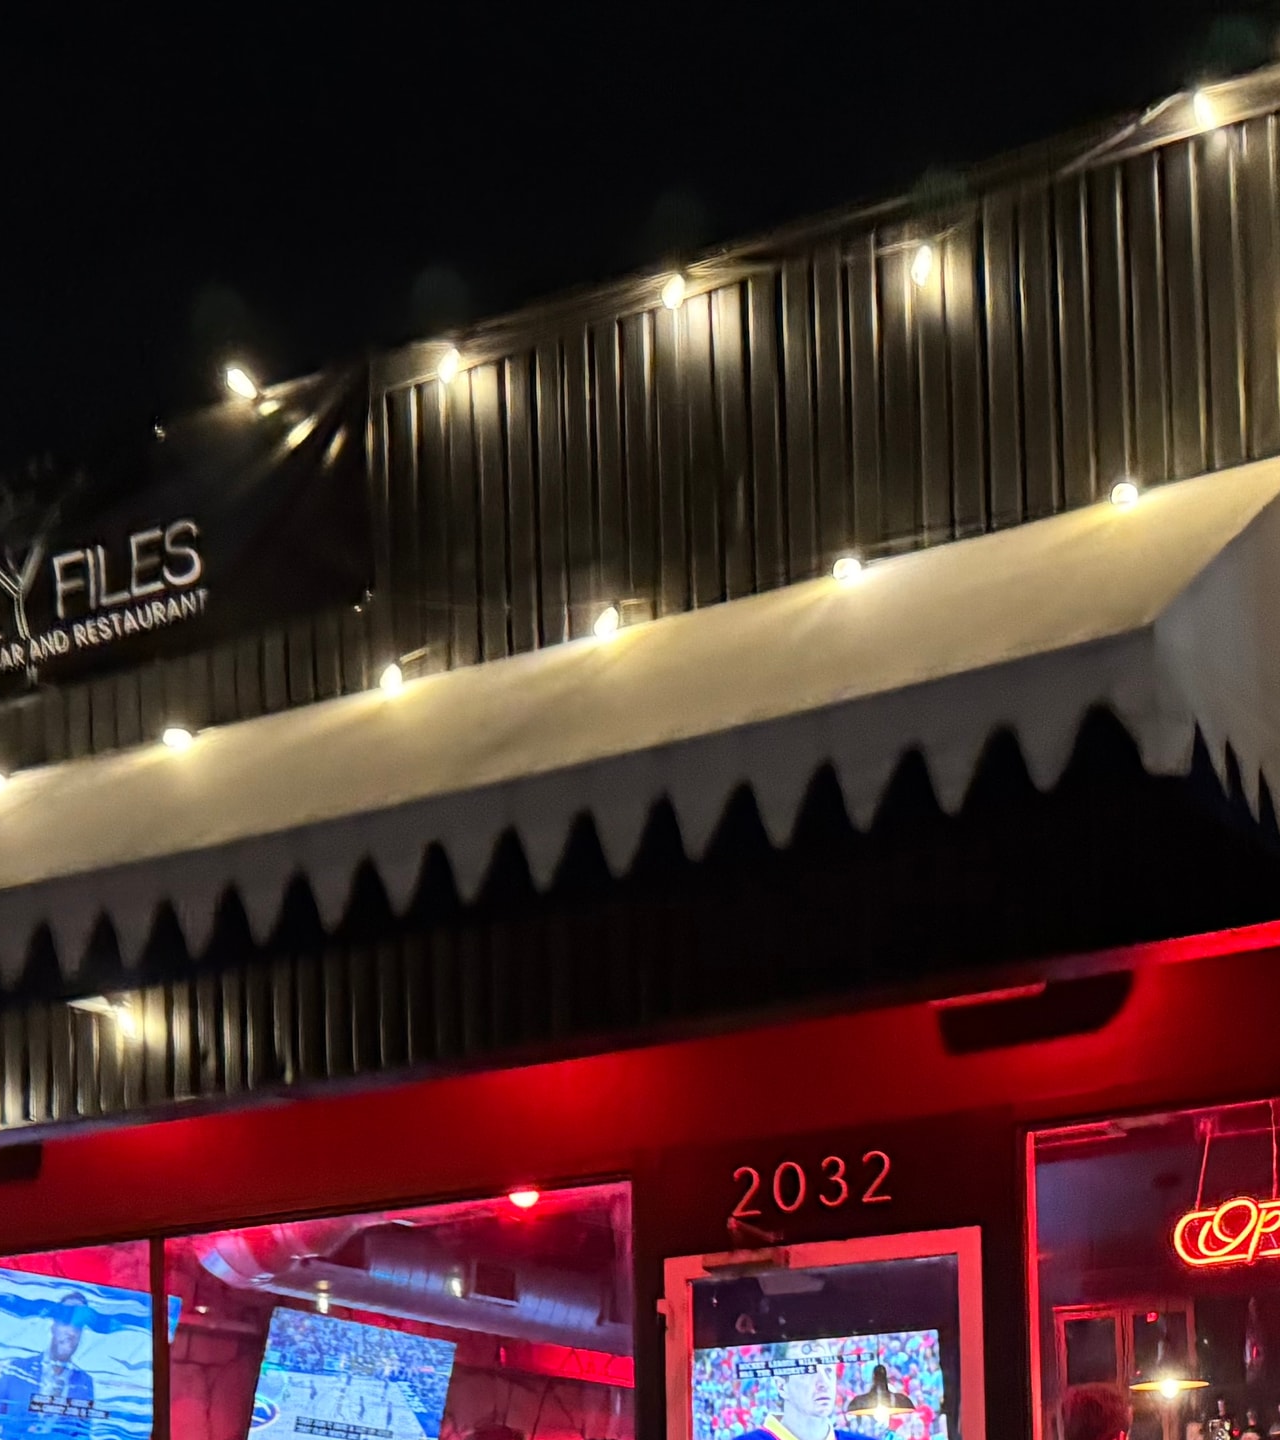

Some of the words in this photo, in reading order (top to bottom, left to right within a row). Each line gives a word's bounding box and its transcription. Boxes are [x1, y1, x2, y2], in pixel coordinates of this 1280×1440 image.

[53, 518, 203, 619] FILES
[30, 629, 69, 661] AND
[73, 588, 208, 648] RESTAURANT
[733, 1150, 892, 1217] 2032
